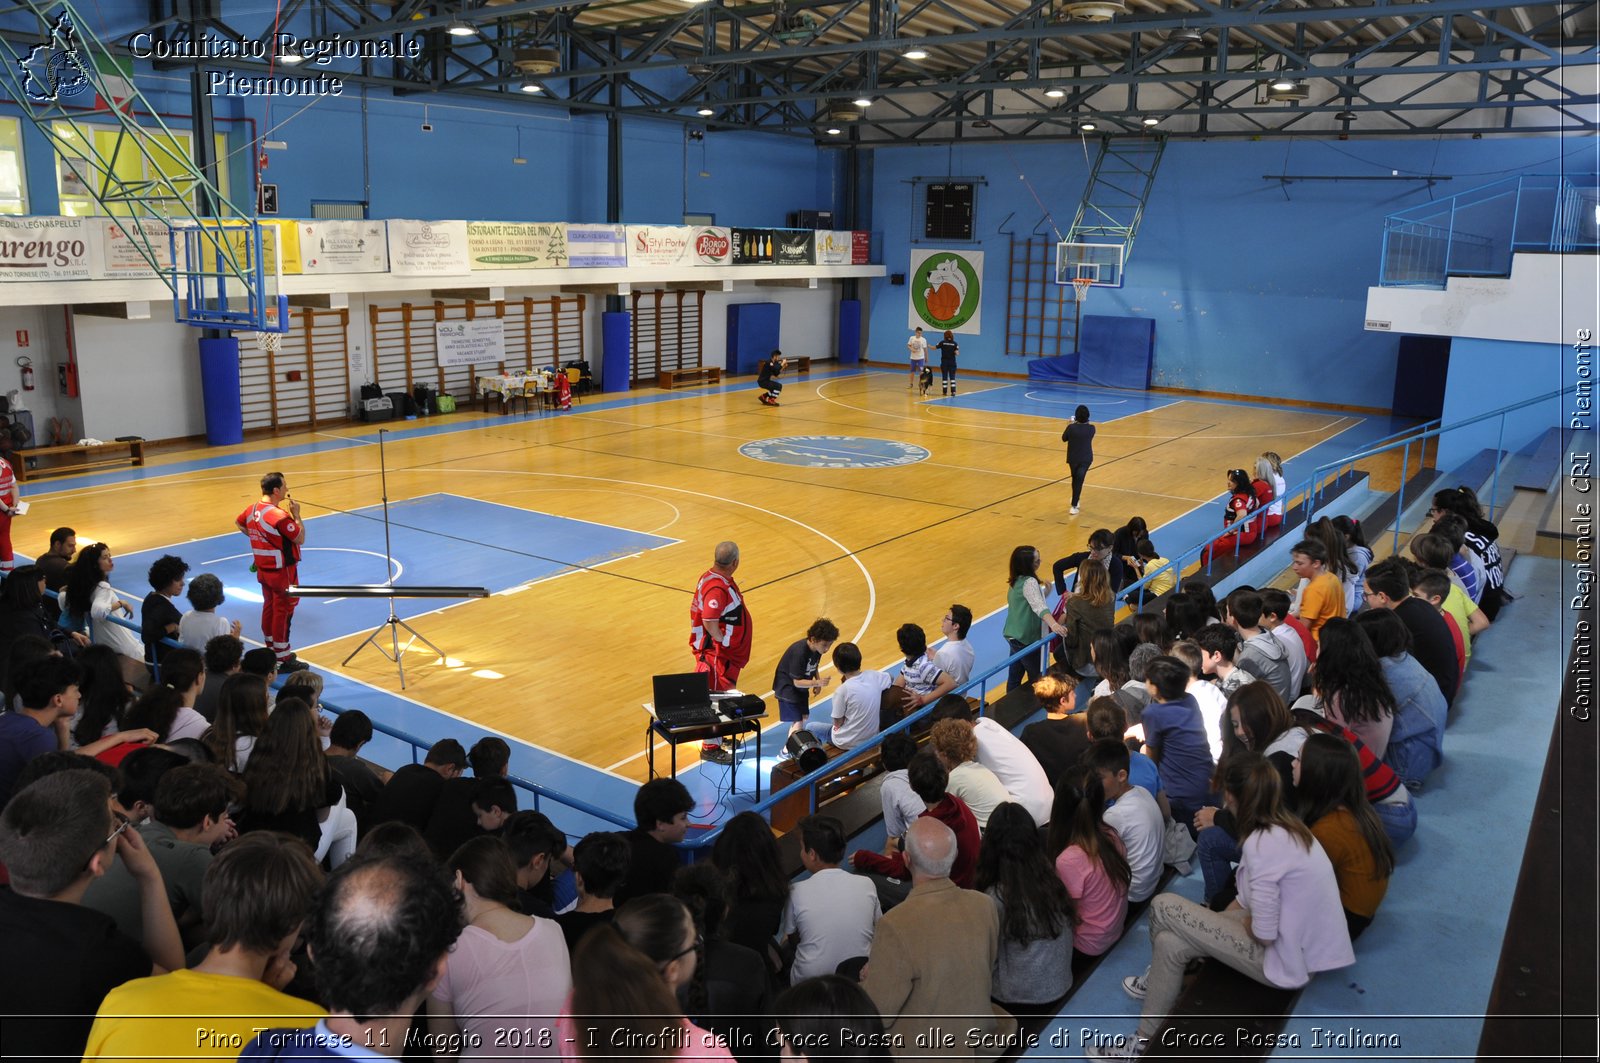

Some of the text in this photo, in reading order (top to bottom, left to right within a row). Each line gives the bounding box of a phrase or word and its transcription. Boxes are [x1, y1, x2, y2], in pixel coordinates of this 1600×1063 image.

[466, 225, 551, 236] RISTORANTE PIZZERIA DEL PINO
[665, 238, 686, 247] Porte
[702, 236, 727, 248] BORGO
[699, 243, 721, 255] DORA
